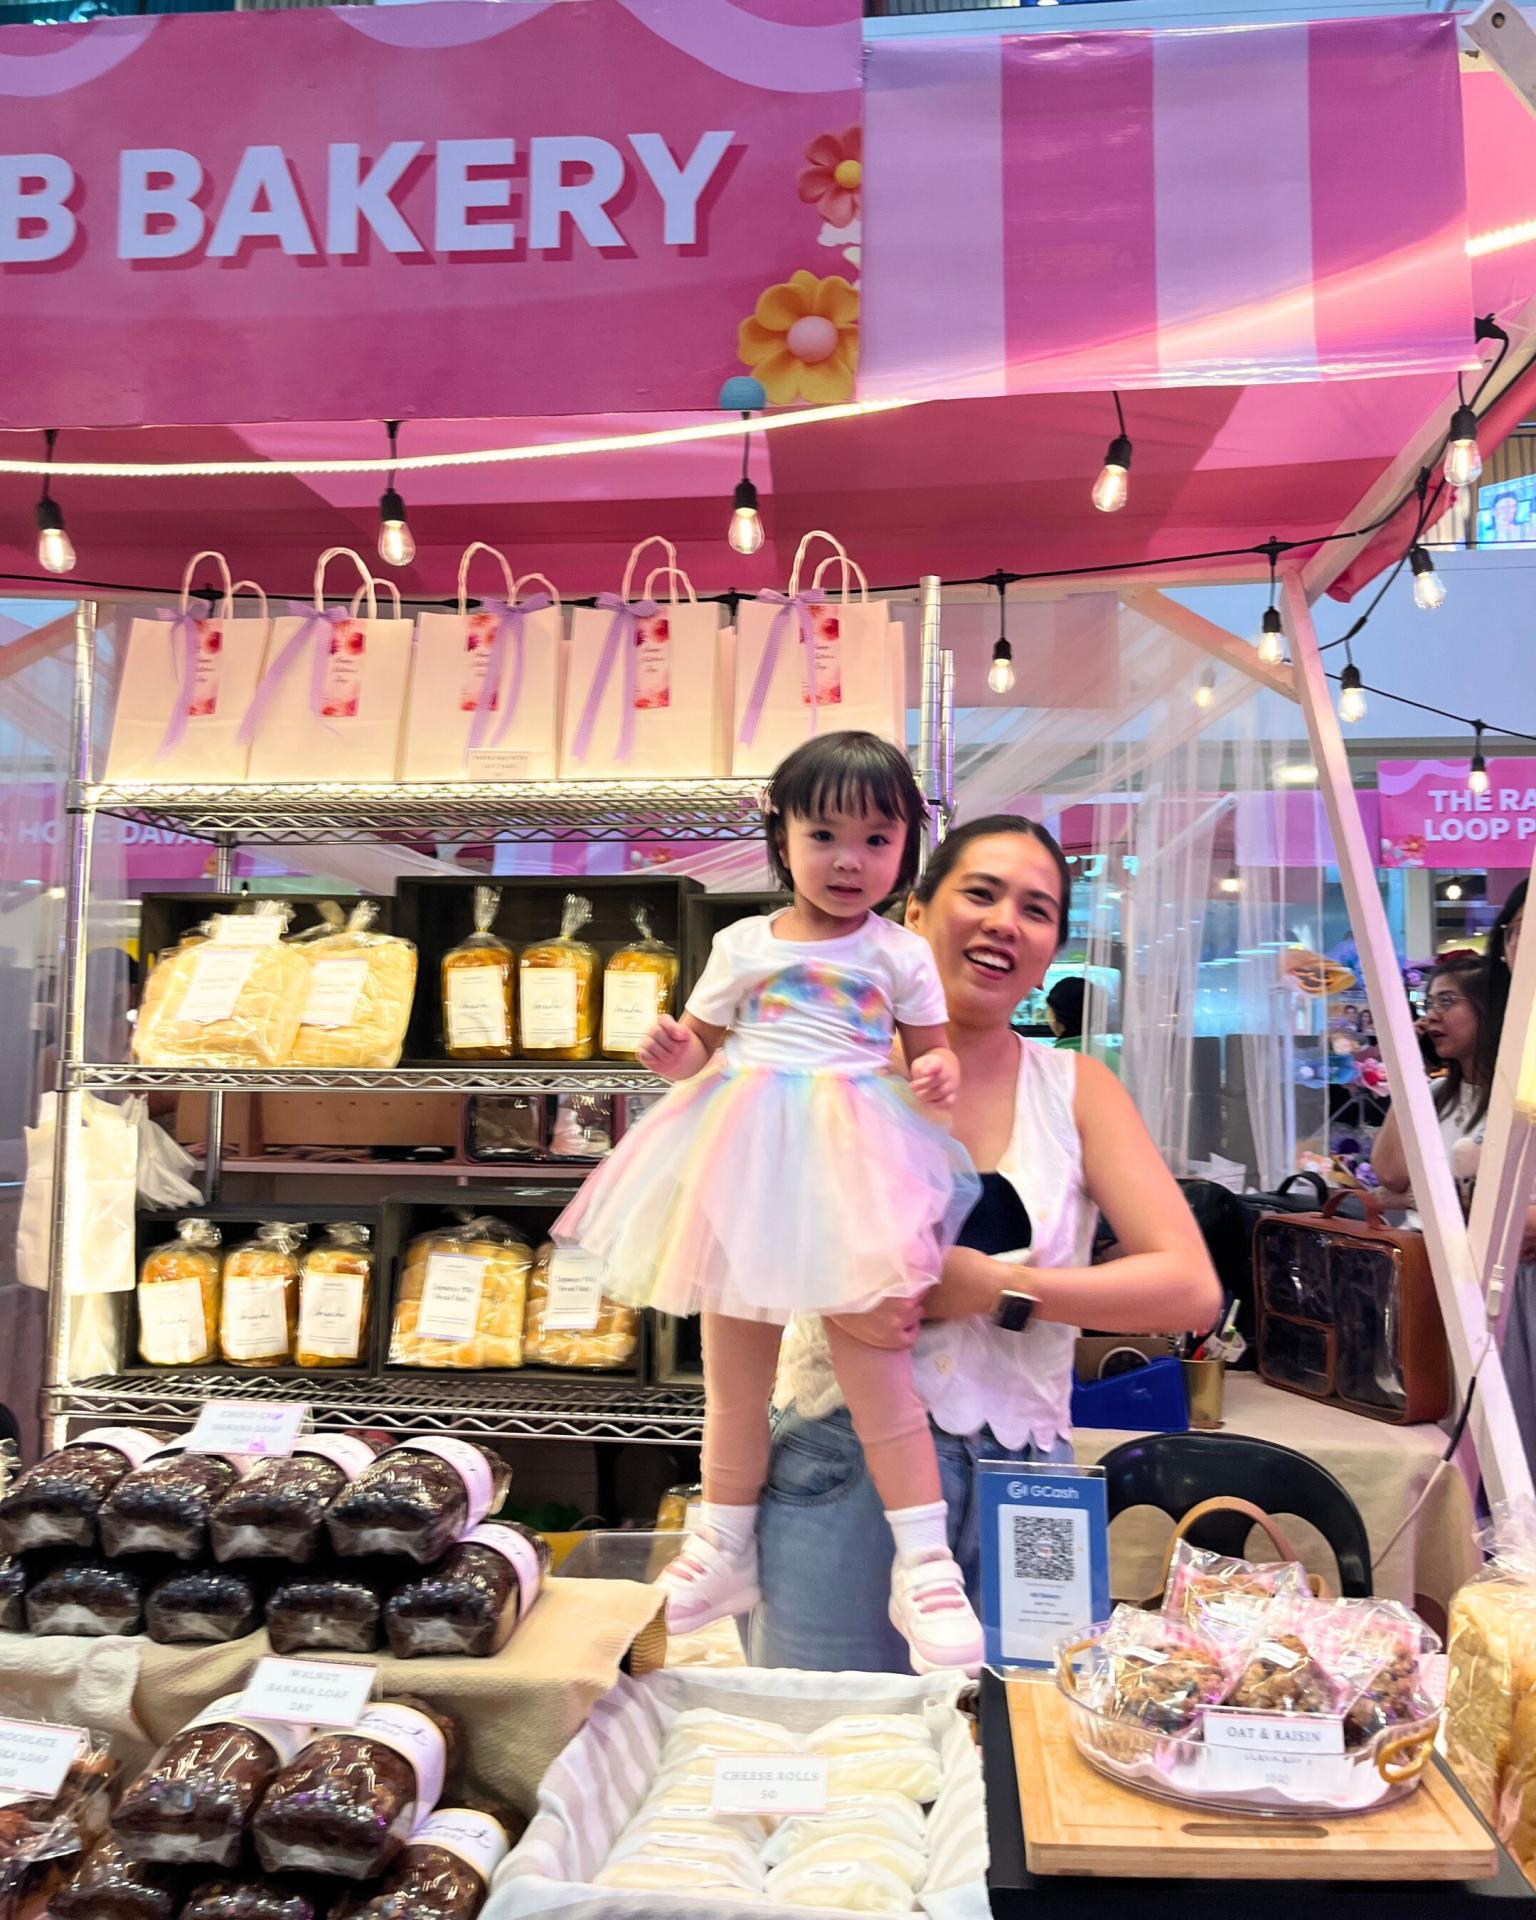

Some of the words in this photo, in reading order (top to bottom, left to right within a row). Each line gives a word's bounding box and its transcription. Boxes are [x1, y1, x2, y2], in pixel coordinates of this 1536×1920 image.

[0, 153, 77, 264] B
[116, 130, 737, 261] BAKERY
[1427, 788, 1492, 813] THE
[1424, 817, 1510, 842] LOOP
[1030, 1485, 1079, 1500] GCash
[265, 1682, 316, 1696] BANANA
[316, 1687, 351, 1700] LOAF
[1226, 1726, 1256, 1739] OAT
[1259, 1727, 1271, 1739] &
[1274, 1729, 1322, 1742] RAISIN
[721, 1770, 774, 1781] CHEESE
[776, 1770, 819, 1781] ROLLS
